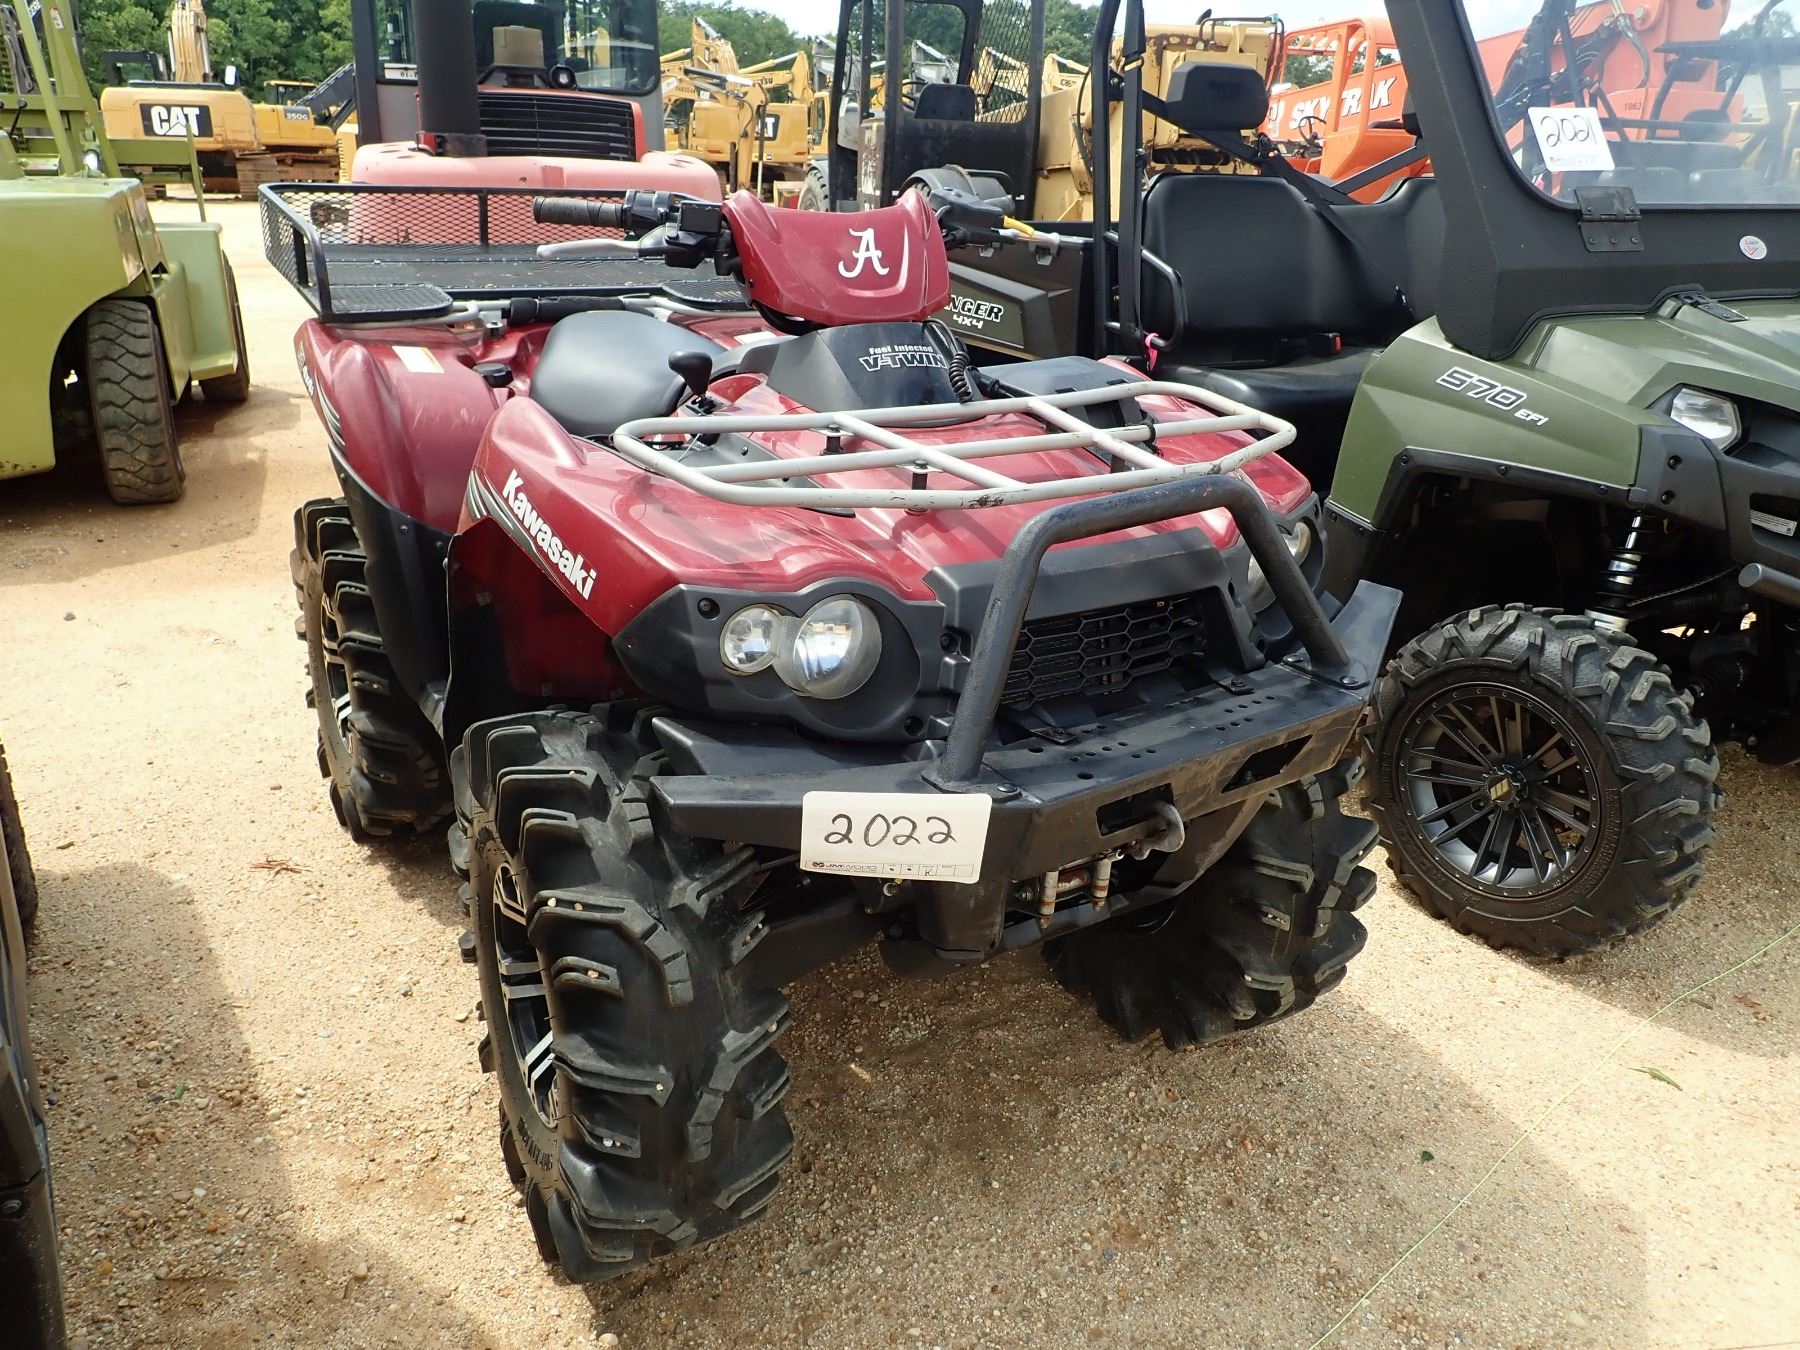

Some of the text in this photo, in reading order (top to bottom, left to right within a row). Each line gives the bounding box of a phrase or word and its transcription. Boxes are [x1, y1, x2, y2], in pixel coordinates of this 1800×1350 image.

[1289, 76, 1398, 130] SKYRK
[150, 105, 200, 137] CAT
[1540, 114, 1598, 148] 2021
[837, 227, 890, 279] A
[943, 294, 1004, 323] NGER
[858, 352, 948, 372] V-TWIN
[894, 344, 934, 353] Injected
[1435, 366, 1550, 426] 570 EFI
[502, 468, 597, 601] Kawasaki
[823, 813, 958, 848] 2022
